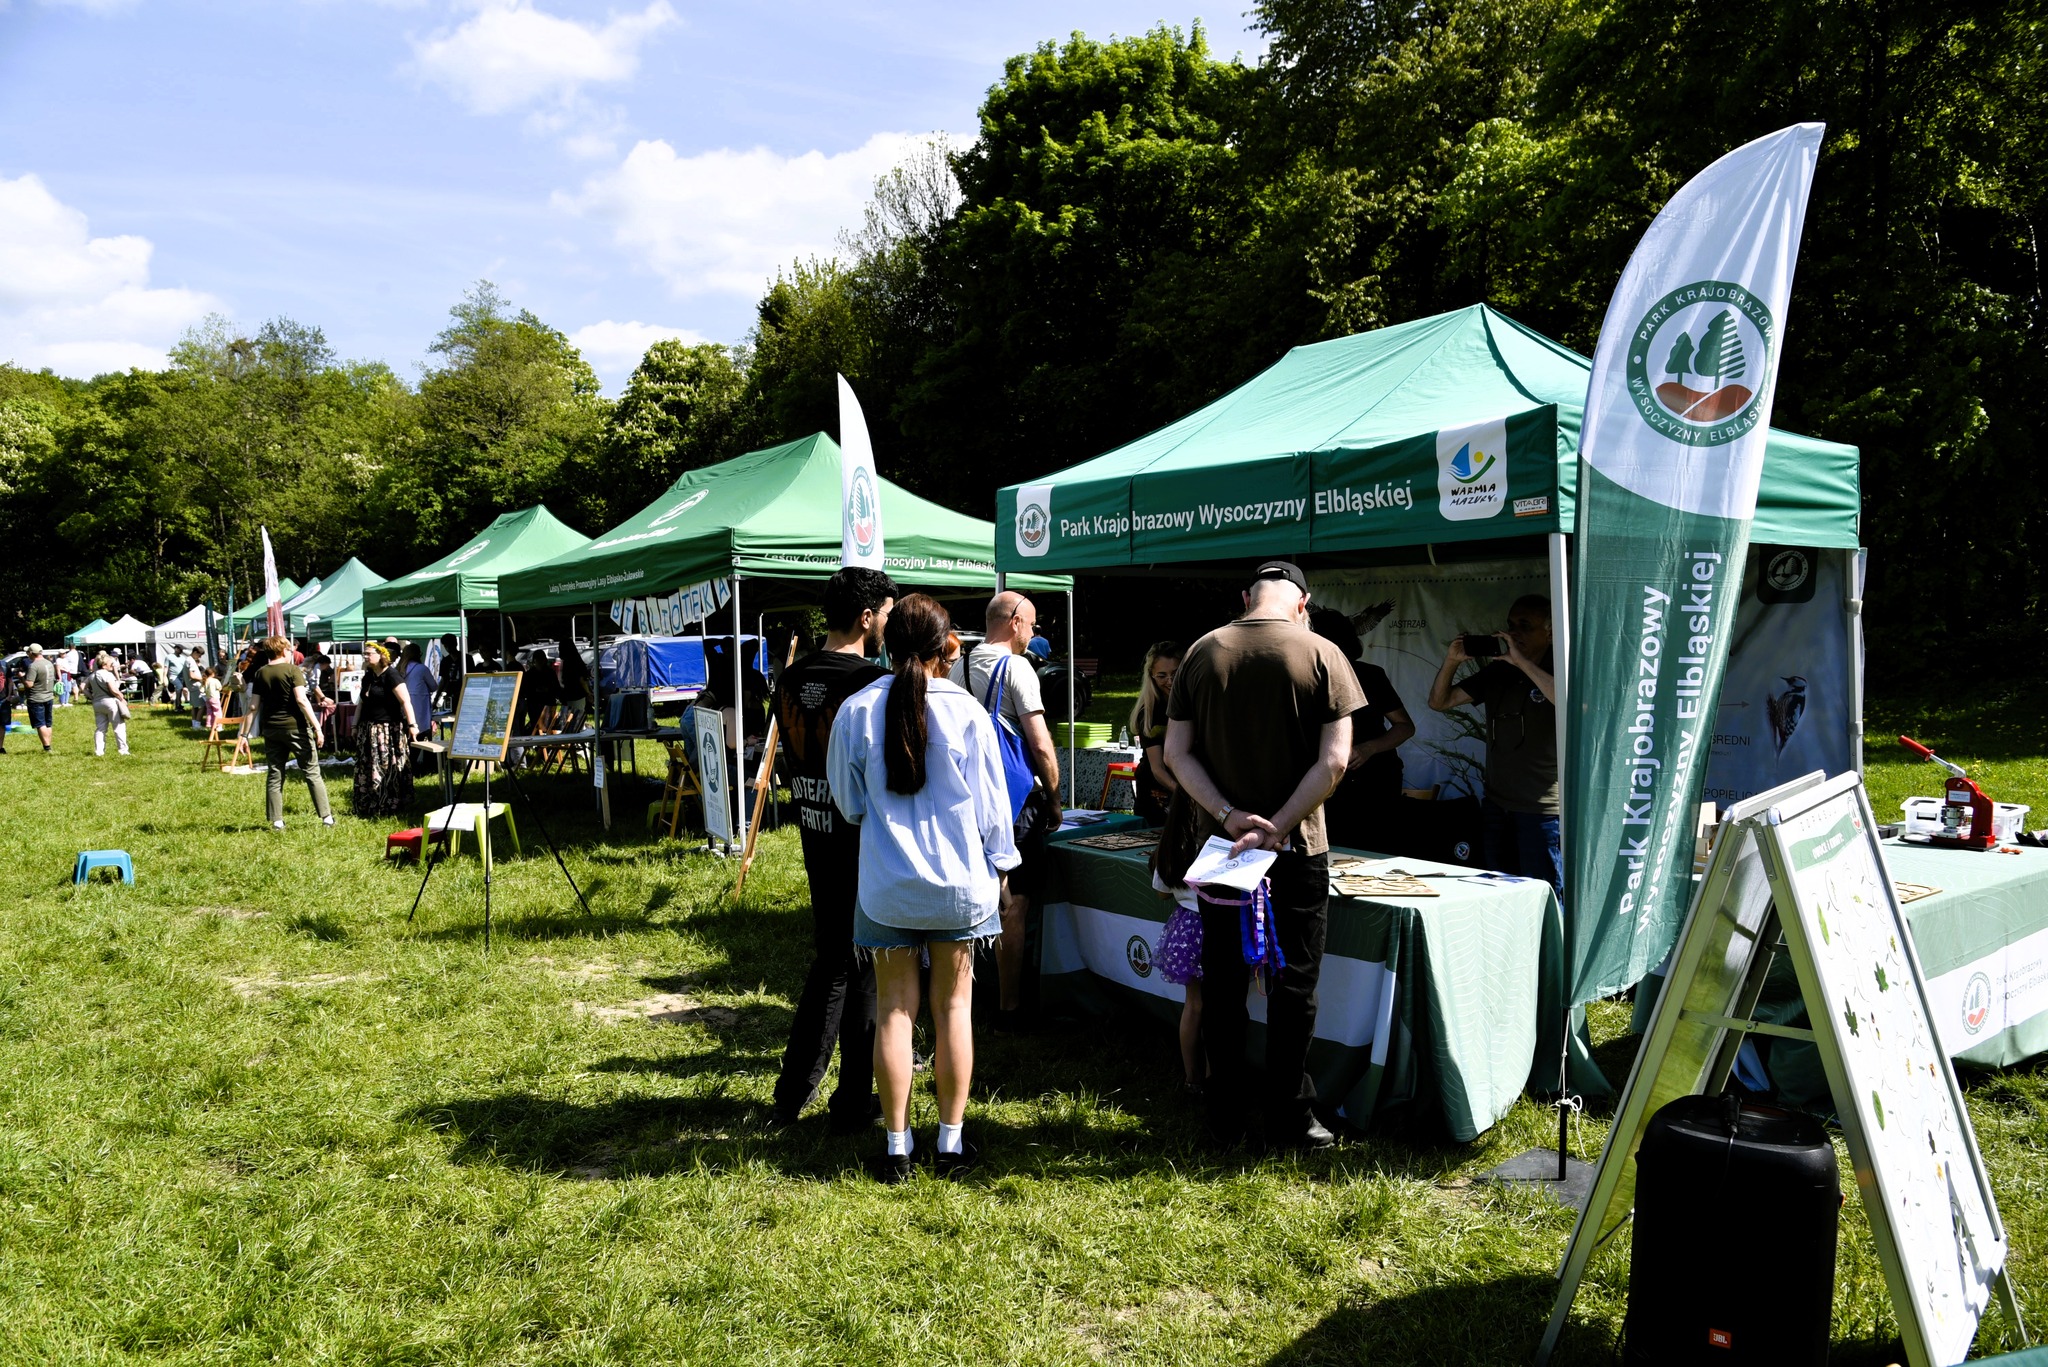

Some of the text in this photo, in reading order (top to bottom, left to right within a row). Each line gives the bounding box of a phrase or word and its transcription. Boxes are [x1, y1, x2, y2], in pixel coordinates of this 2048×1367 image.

[1639, 303, 1671, 341] PARK
[1631, 376, 1702, 443] WYSOCZYZNY
[1449, 493, 1496, 507] MAZURY
[1451, 482, 1497, 497] WARMIA
[1060, 516, 1091, 538] Park
[1198, 497, 1307, 530] Wysoczyzny
[1314, 479, 1414, 516] Elbląskiej
[929, 556, 955, 571] Lasy
[611, 579, 729, 635] BIBLIOTEKA
[1388, 619, 1427, 630] JASTRZĄB
[1675, 551, 1723, 720] Elbląskiej
[1618, 584, 1671, 916] Park Krajobrazowy
[1703, 787, 1758, 801] POPIELIC
[800, 805, 833, 834] FAITH
[1713, 1333, 1728, 1345] JBL
